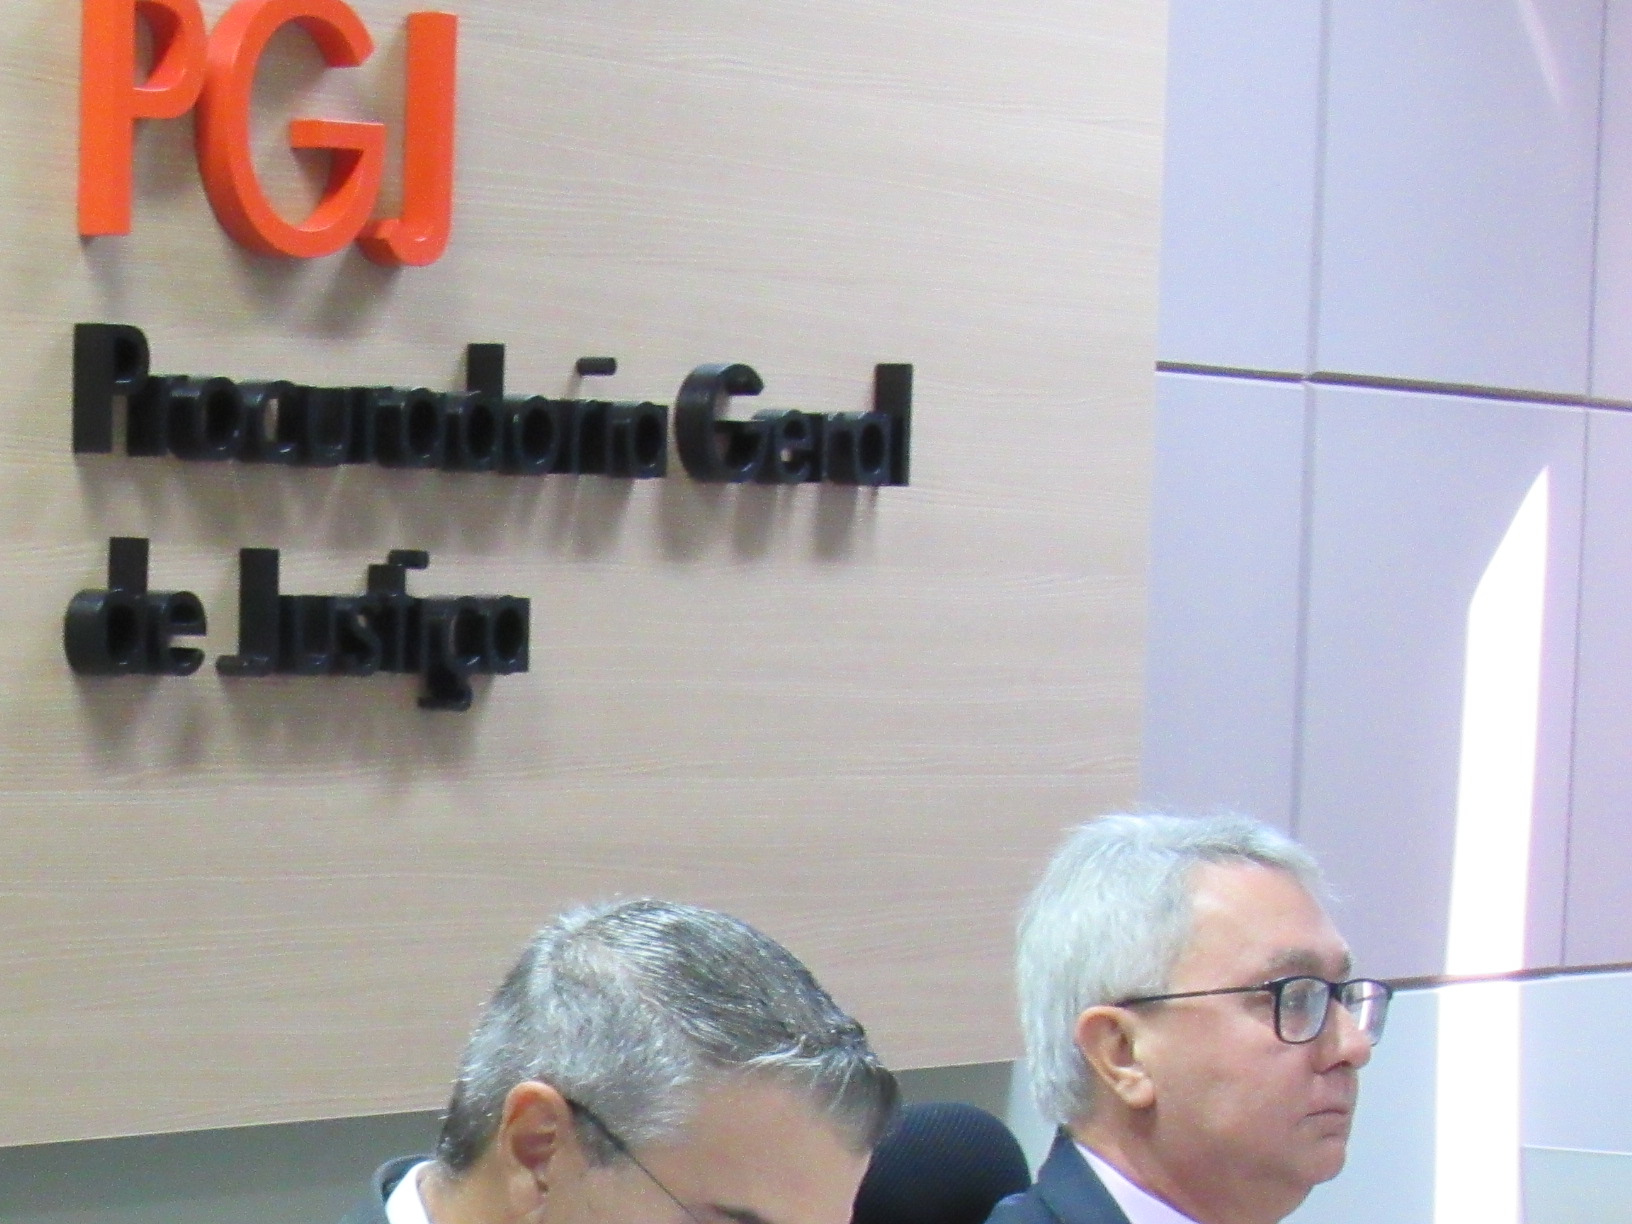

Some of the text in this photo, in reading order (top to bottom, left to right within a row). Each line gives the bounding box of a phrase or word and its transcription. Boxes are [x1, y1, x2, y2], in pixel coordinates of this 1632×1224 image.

[77, 0, 460, 267] PGJ
[675, 362, 914, 487] Geral
[64, 536, 531, 711] de Justiça
